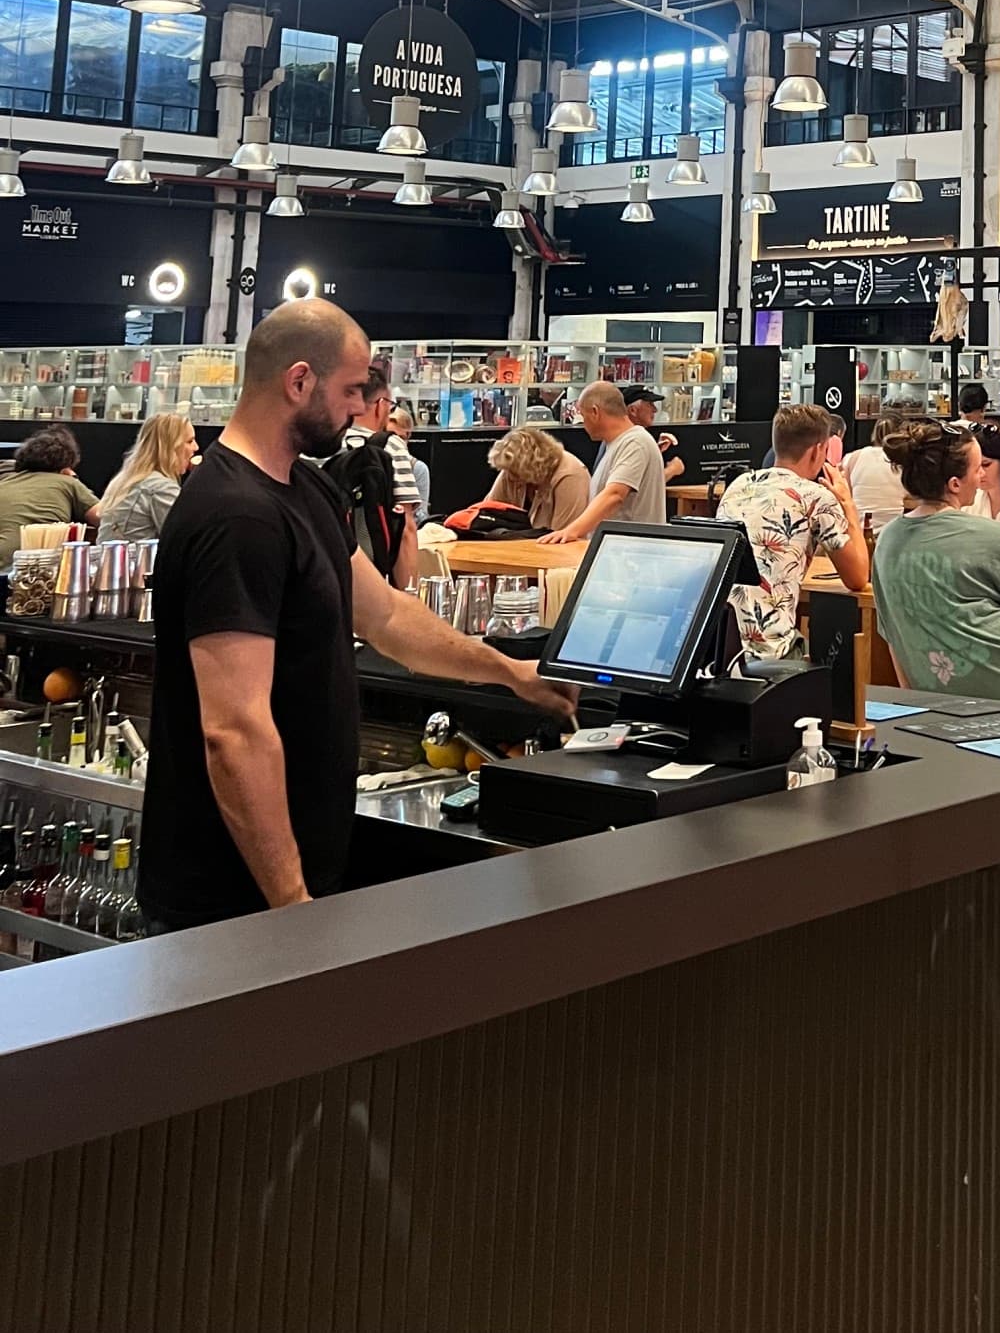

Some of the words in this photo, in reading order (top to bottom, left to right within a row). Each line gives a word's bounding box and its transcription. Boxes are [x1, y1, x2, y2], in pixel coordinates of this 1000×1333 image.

[396, 39, 406, 61] A
[411, 41, 444, 67] VIDA
[372, 64, 463, 98] PORTUGUESA
[823, 203, 891, 235] TARTINE
[22, 224, 78, 235] MARKET
[121, 274, 135, 287] WC
[323, 282, 336, 295] WC
